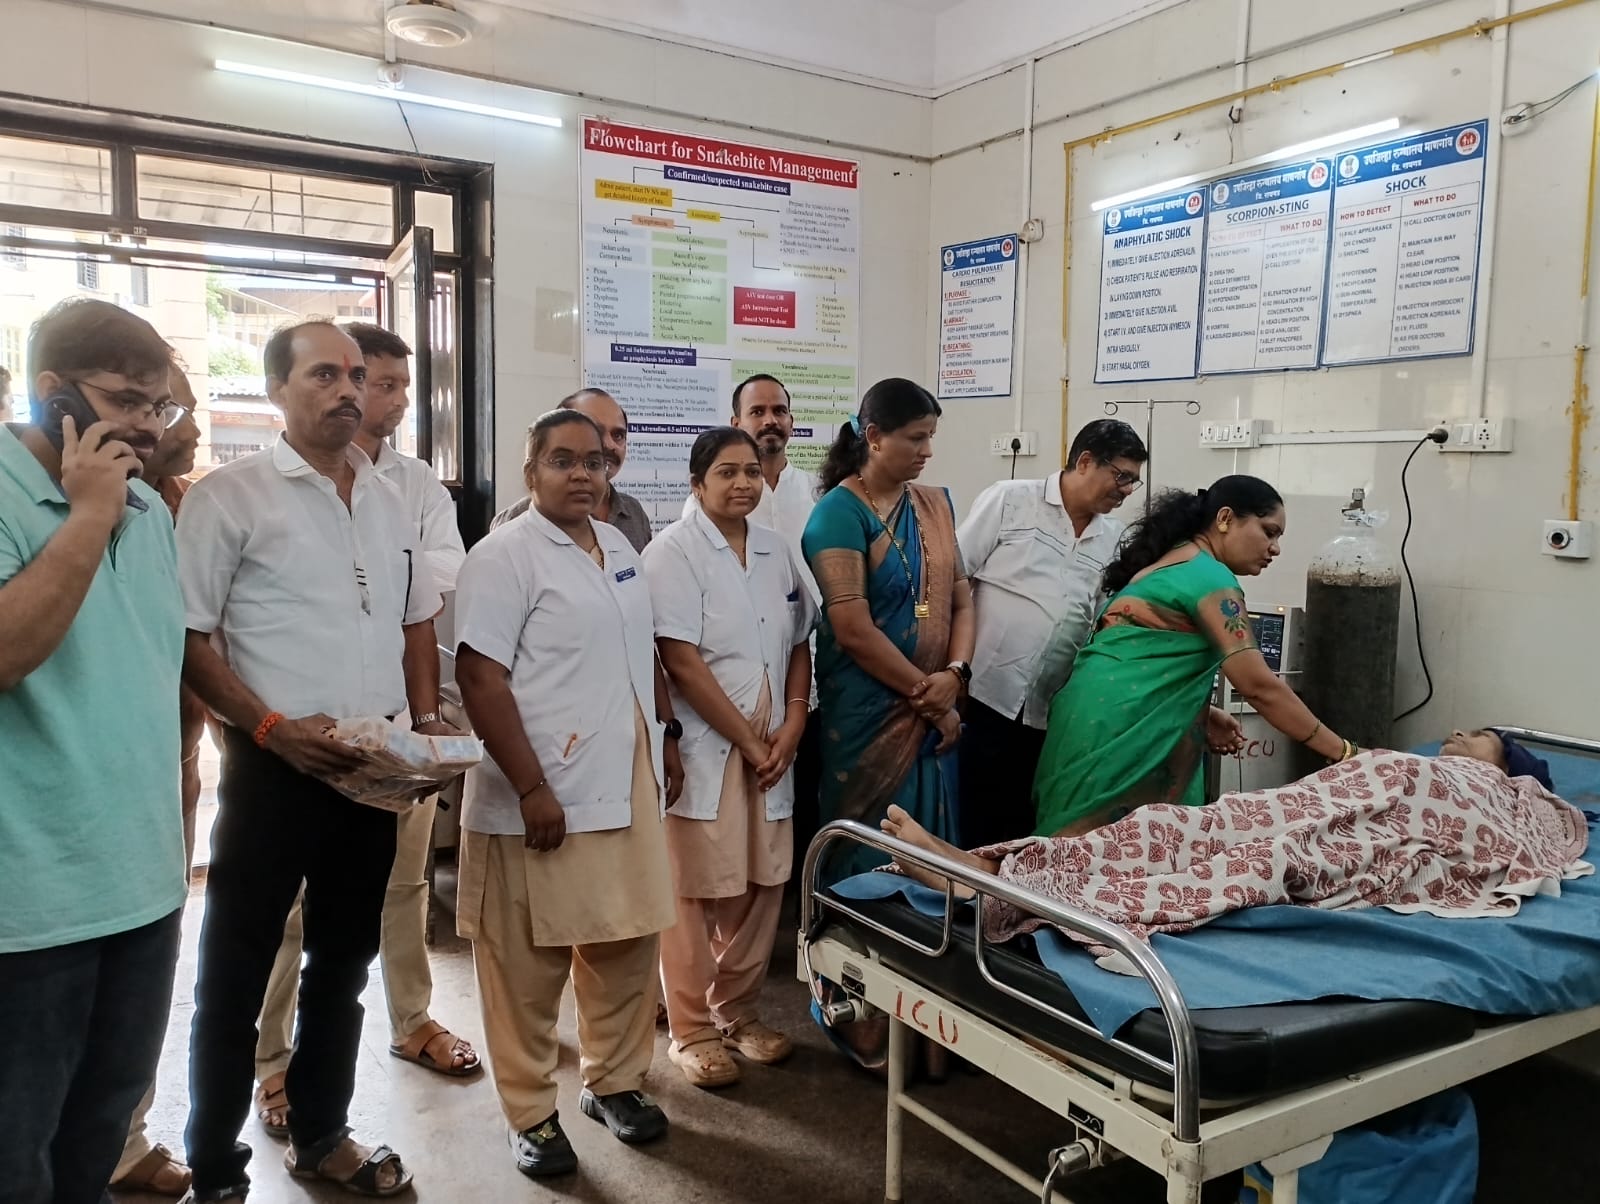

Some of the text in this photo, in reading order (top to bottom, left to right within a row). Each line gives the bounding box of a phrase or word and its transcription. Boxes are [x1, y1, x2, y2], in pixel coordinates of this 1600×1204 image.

[589, 127, 855, 183] Flowchart for Snakebite Management
[667, 168, 788, 193] Confirmed/suspected snakebite case
[1386, 176, 1426, 193] SHOCK
[1414, 198, 1432, 206] WHAT
[1227, 200, 1309, 223] SCORPION-STING
[1367, 205, 1391, 215] DETECT
[1424, 214, 1445, 222] DOCTOR
[1281, 223, 1299, 232] WHAT
[1359, 224, 1392, 233] APPEARANCE
[1114, 226, 1191, 248] ANAPHYLATIC SHOCK
[1344, 248, 1368, 256] SWEATING
[1112, 256, 1137, 267] IMMEDIATELY
[1139, 254, 1147, 263] GIVE
[1149, 251, 1170, 262] INJECTION
[972, 264, 1003, 274] PULMONARY
[1111, 275, 1124, 284] CHECK
[1146, 271, 1159, 279] PULSE
[1169, 265, 1198, 277] RESPIRATION
[1342, 268, 1376, 277] HYPOTENSION
[1342, 278, 1375, 286] TACHYCARDIA
[1129, 291, 1141, 300] DOWN
[1142, 288, 1161, 298] POSITION
[1341, 298, 1376, 307] TEMPERATURE
[1109, 309, 1134, 319] IMMEDIATELY
[1136, 308, 1144, 316] GIVE
[1146, 306, 1166, 315] INJECTION
[1108, 324, 1168, 336] START AND GIVE INJECTION
[1107, 363, 1119, 371] START
[896, 990, 959, 1045] ICU
